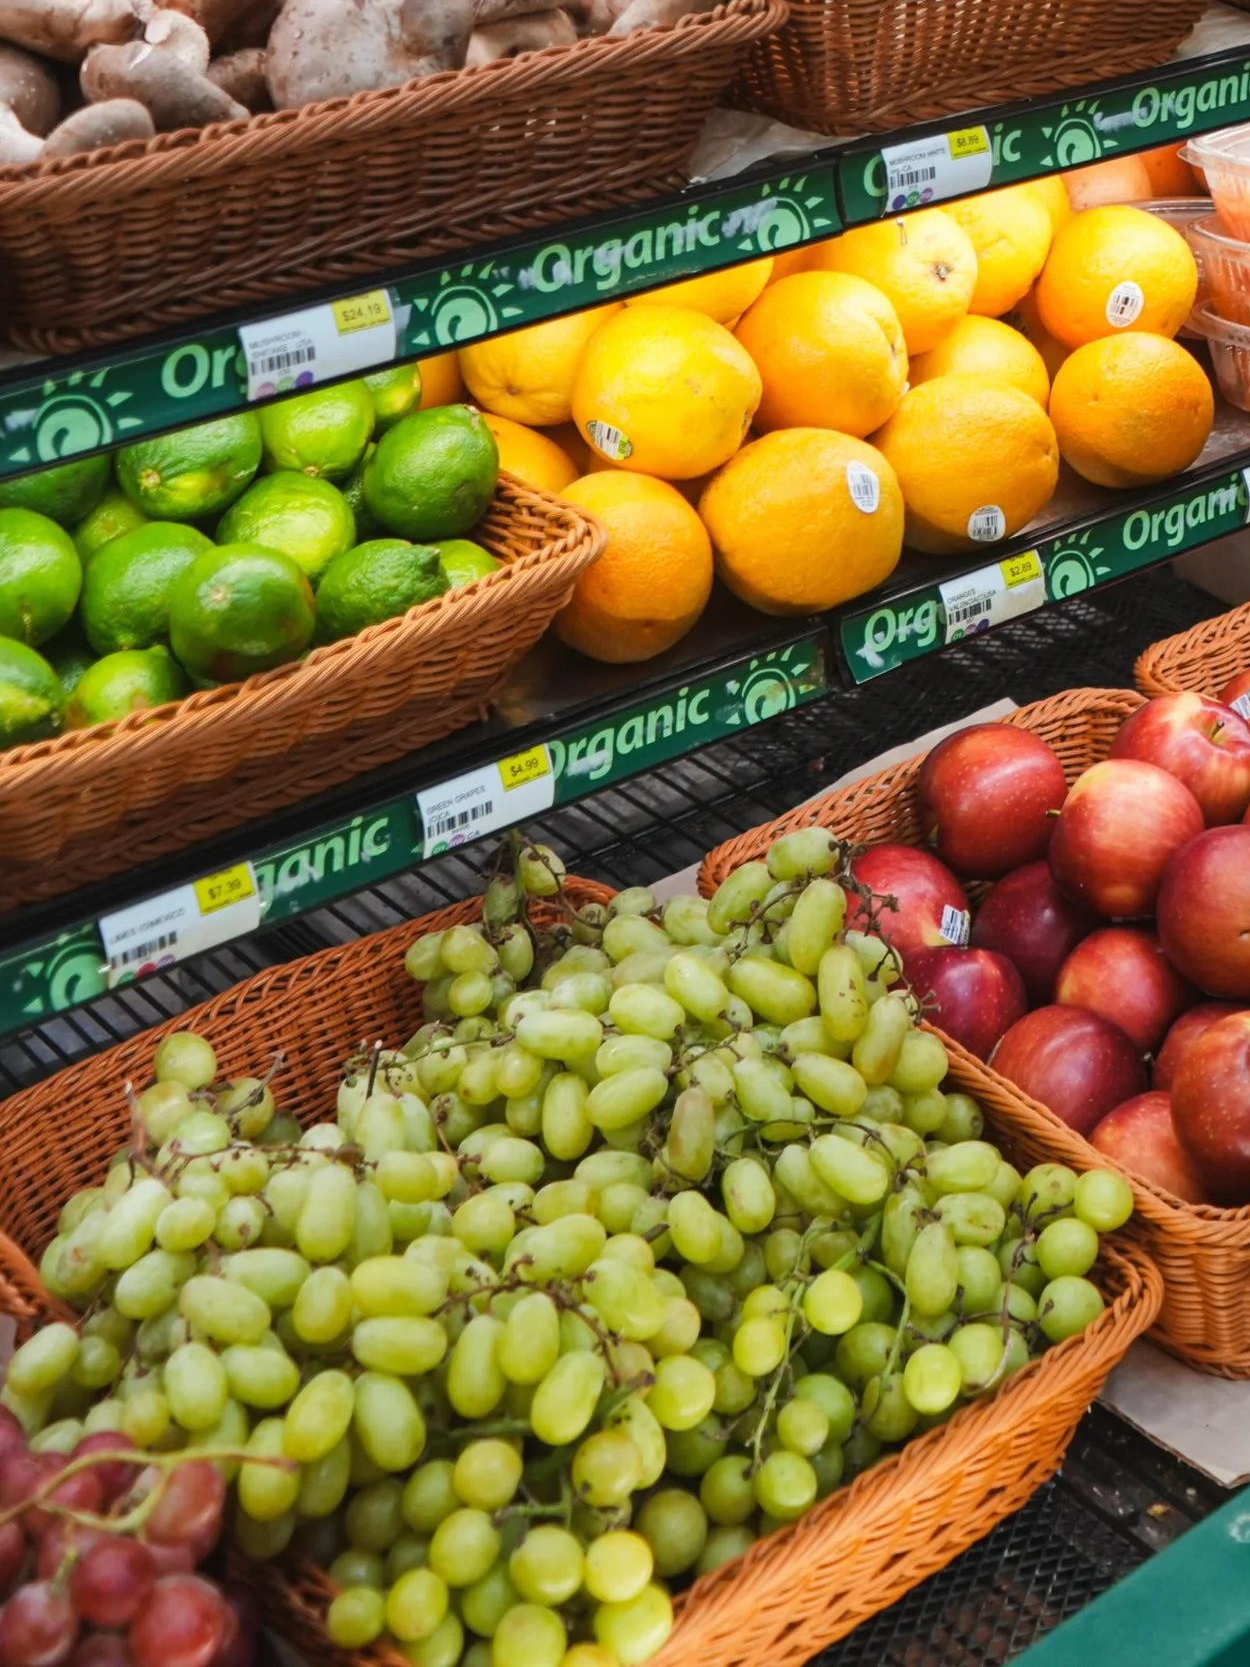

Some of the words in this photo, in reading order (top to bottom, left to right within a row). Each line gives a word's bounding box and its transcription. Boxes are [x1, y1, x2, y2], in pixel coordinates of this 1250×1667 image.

[889, 151, 927, 167] MUSHROOM
[927, 147, 946, 159] WHITE
[532, 204, 722, 291] Organic
[341, 303, 382, 322] $24.19
[1010, 562, 1033, 578] $2.89
[947, 588, 976, 604] ORANGES
[549, 686, 711, 781] Organic
[510, 757, 540, 778] $4.99
[426, 798, 454, 816] GREEN
[455, 784, 487, 803] GRAPES
[256, 814, 390, 915] ganic
[208, 877, 242, 901] $7.39
[110, 926, 139, 946] LIMES
